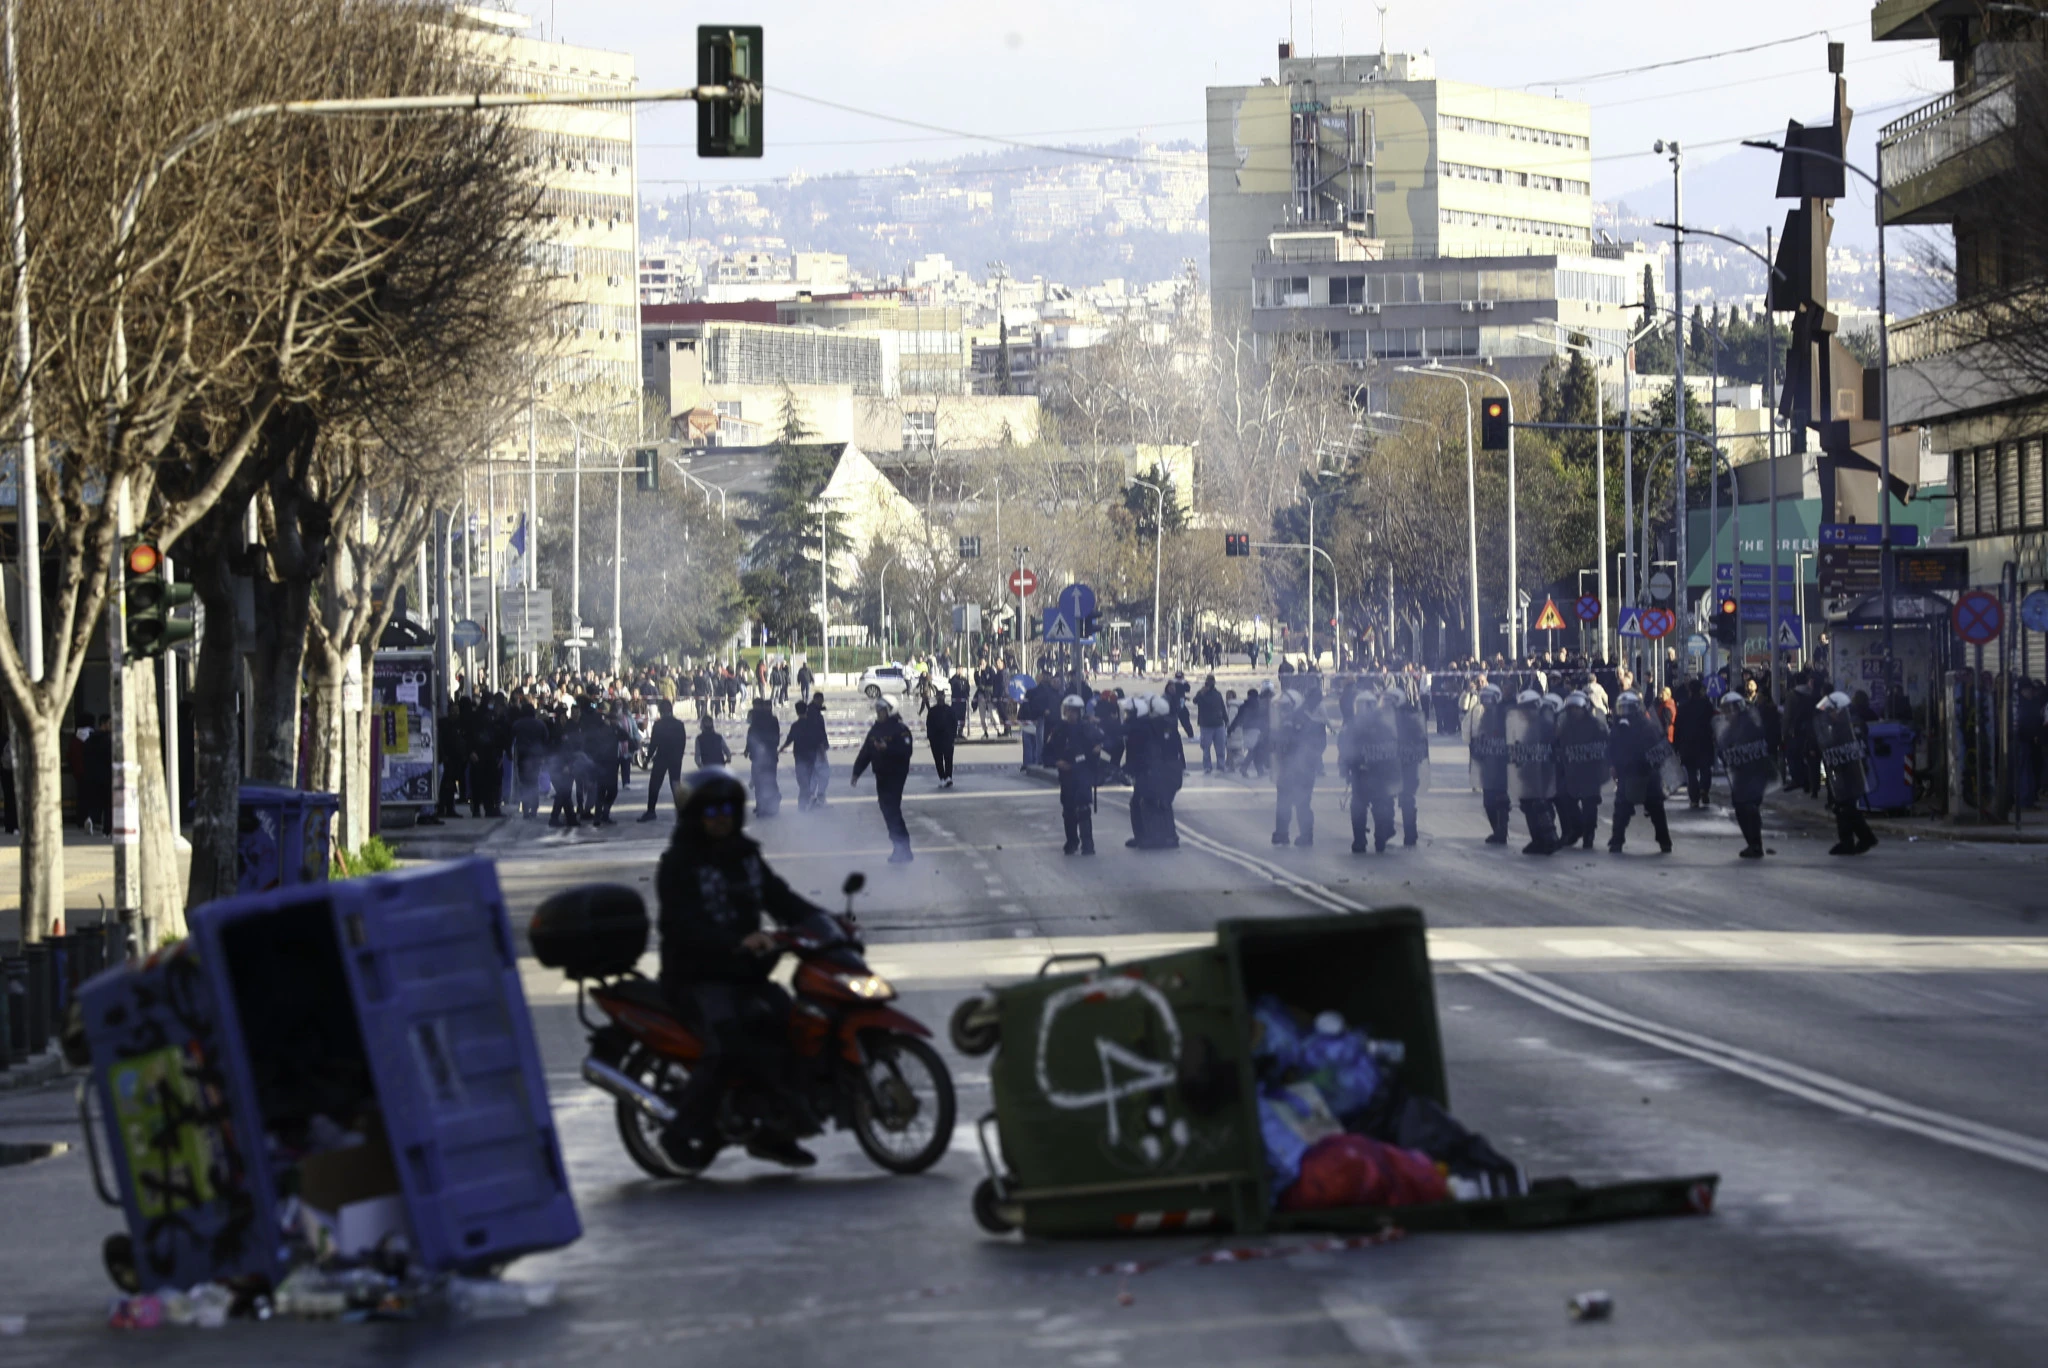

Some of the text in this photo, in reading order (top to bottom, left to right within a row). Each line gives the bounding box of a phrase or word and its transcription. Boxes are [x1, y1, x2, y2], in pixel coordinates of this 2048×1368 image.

[402, 671, 427, 686] 60
[1510, 752, 1548, 762] POLICE
[1568, 750, 1605, 762] POLICE
[1826, 749, 1865, 767] POLICE
